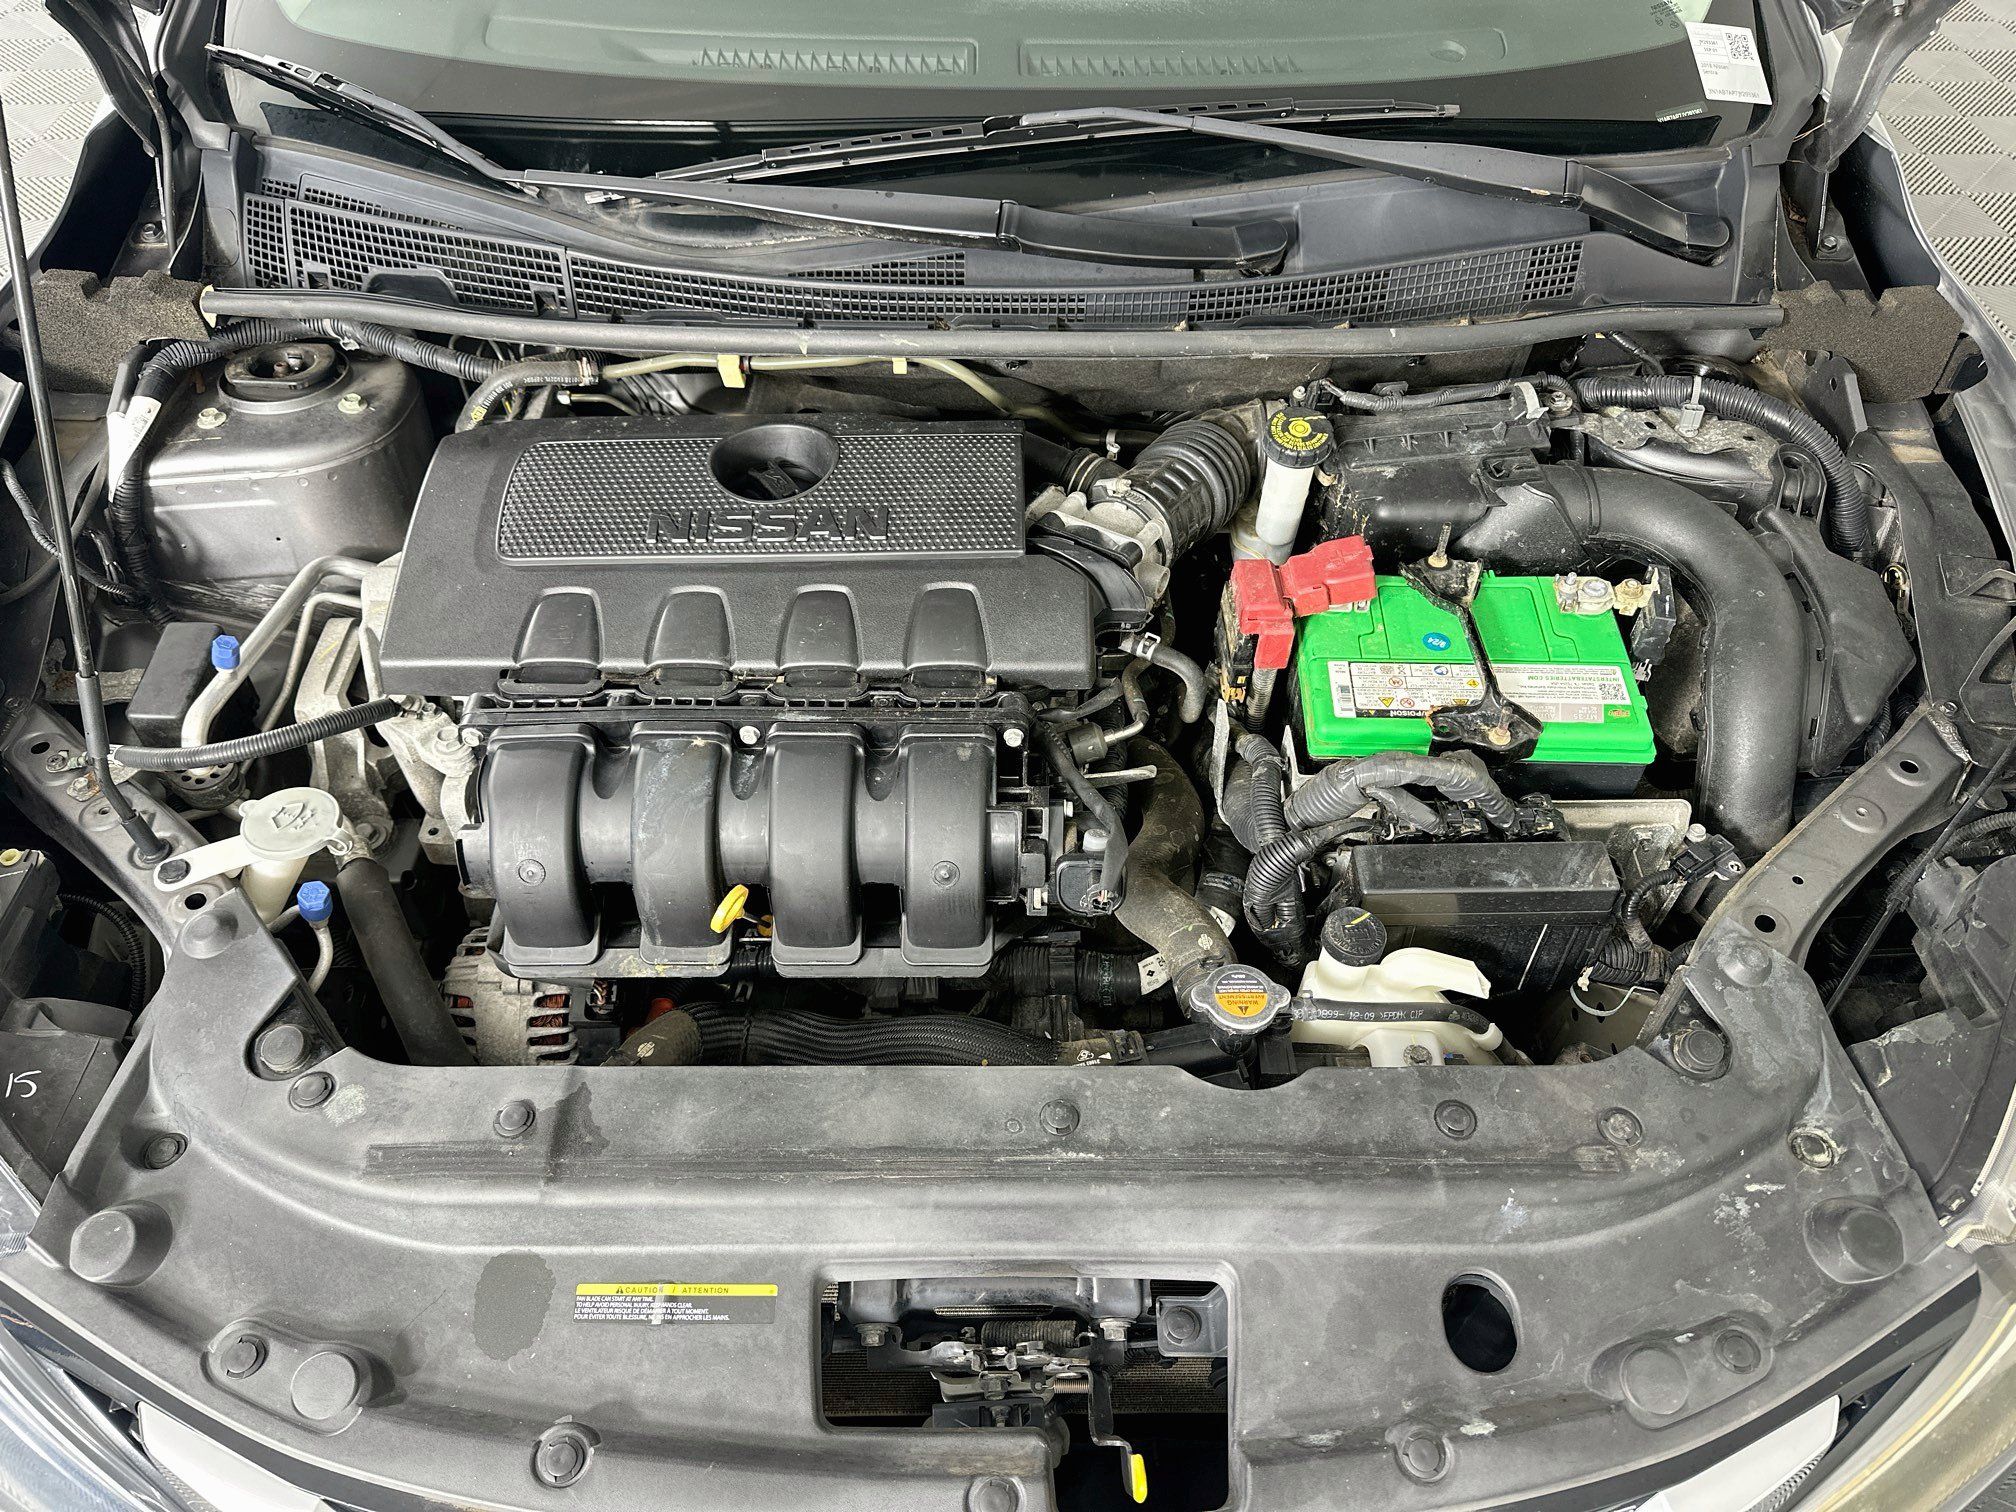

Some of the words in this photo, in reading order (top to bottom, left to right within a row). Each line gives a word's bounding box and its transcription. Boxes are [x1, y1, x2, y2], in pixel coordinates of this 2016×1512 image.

[645, 509, 889, 543] NISSAN
[5, 1070, 42, 1098] 15
[625, 1286, 664, 1294] CAUTION
[681, 1286, 729, 1294] ATTENTION
